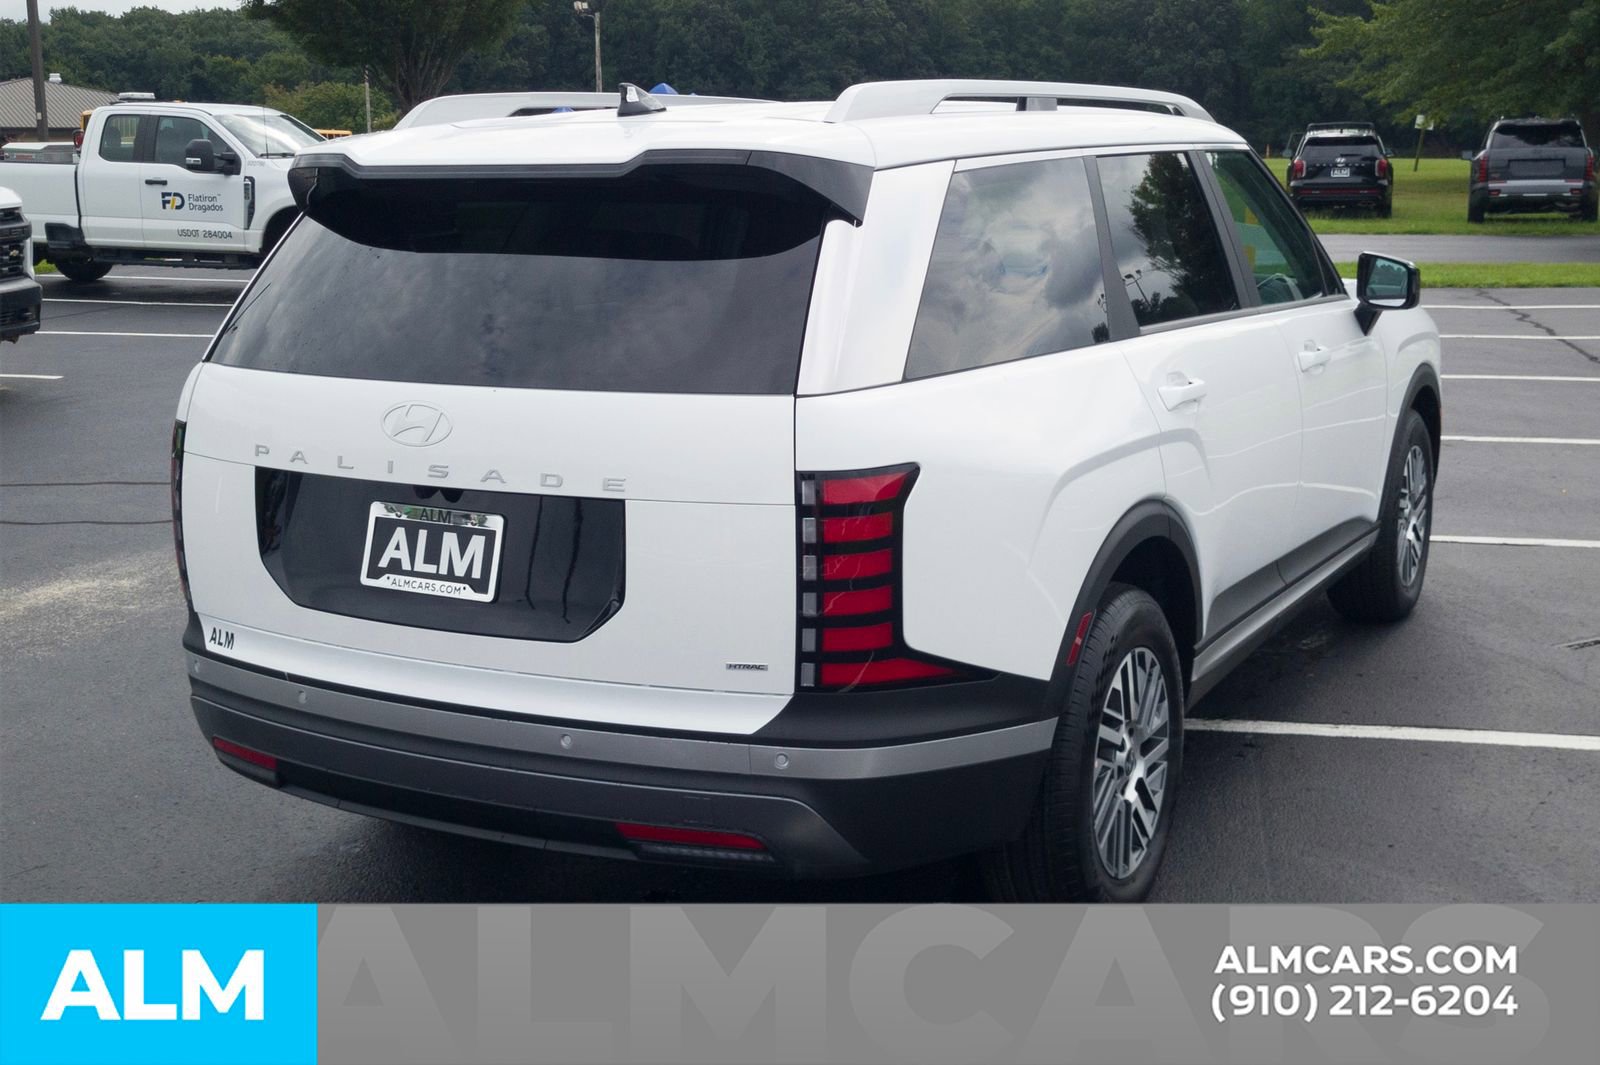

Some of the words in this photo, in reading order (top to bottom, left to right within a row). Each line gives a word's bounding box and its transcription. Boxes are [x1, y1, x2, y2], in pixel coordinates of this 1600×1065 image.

[188, 203, 223, 213] Dragados
[177, 229, 200, 238] USDOT
[203, 230, 233, 239] 284004
[254, 444, 626, 492] PALISADE
[420, 508, 452, 523] ALM
[378, 526, 486, 579] ALM
[390, 578, 462, 595] ALMCARS.COM
[209, 626, 235, 650] ALM
